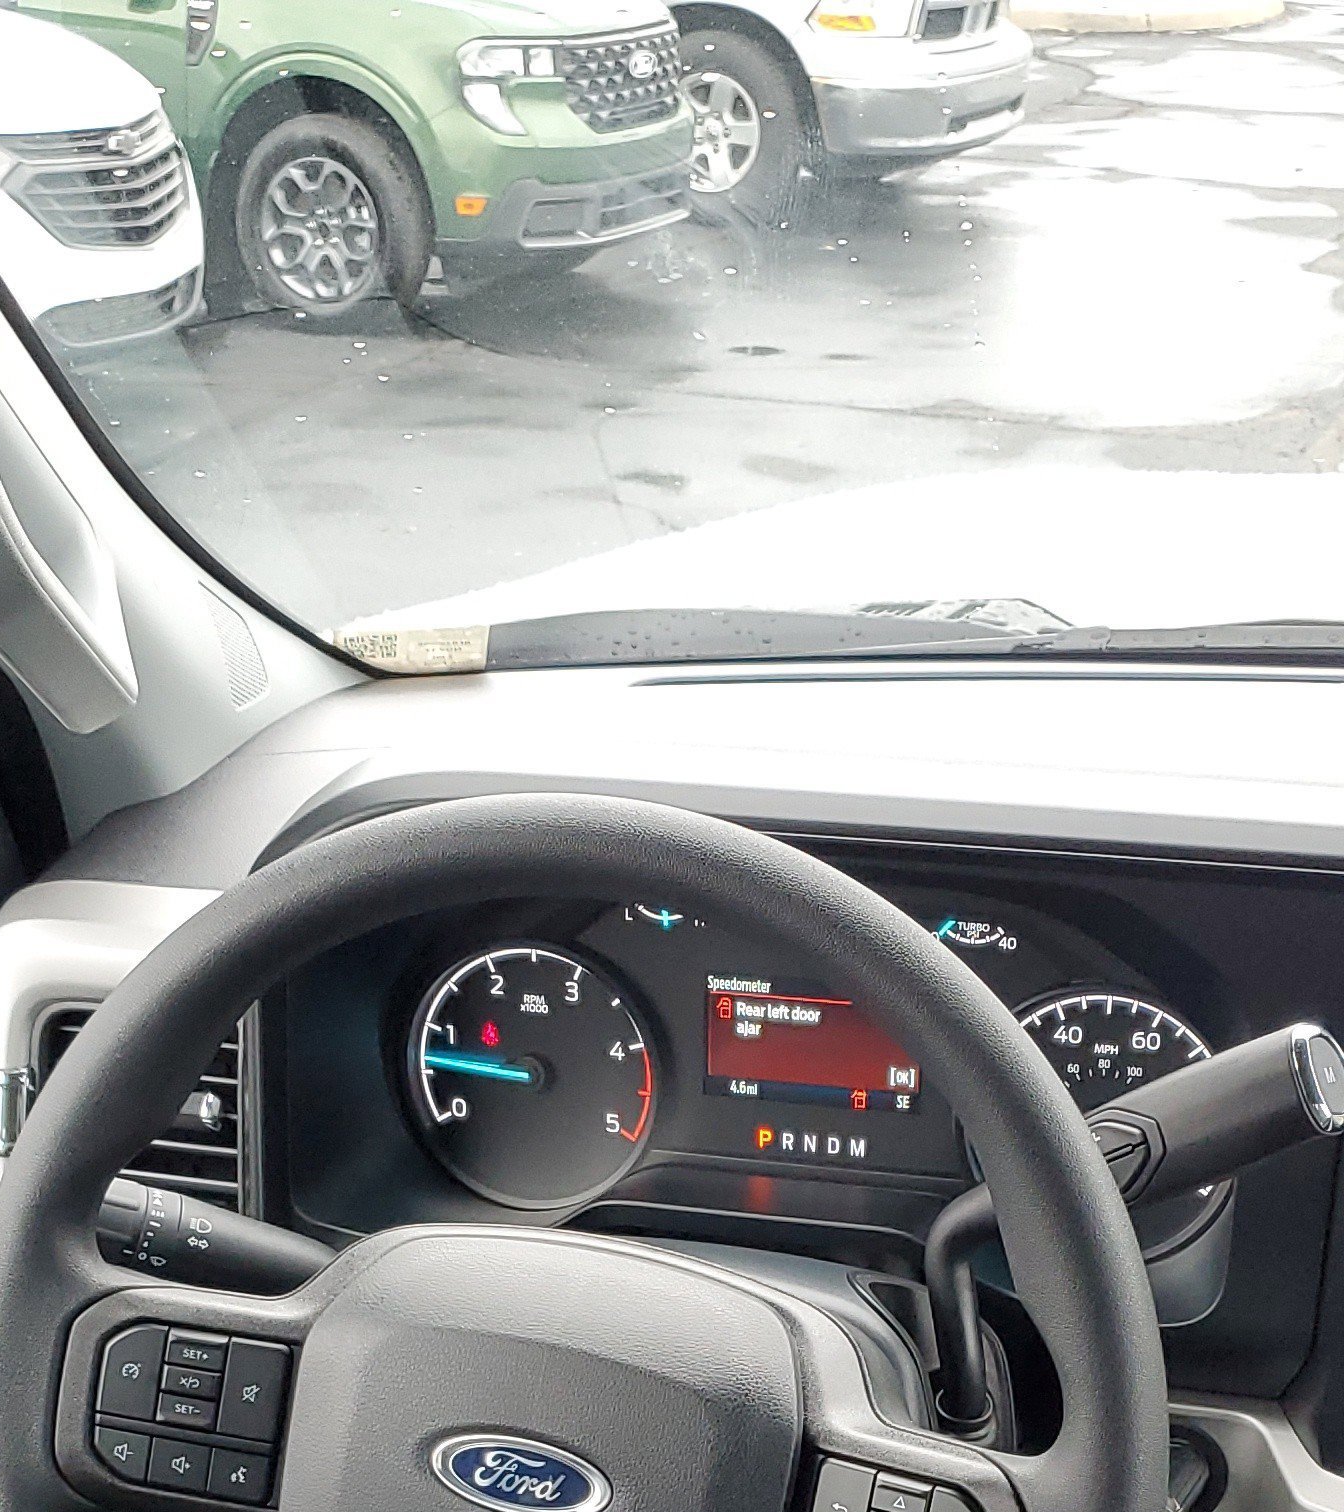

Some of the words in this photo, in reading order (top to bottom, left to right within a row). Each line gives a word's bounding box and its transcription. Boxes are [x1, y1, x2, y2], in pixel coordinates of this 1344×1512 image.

[957, 921, 991, 932] TURBO
[998, 936, 1017, 950] 40
[490, 975, 504, 995] 2
[565, 982, 579, 1002] 3
[707, 976, 771, 993] Speedometer
[523, 994, 546, 1005] RPM
[520, 1003, 548, 1014] x1000
[736, 1001, 765, 1017] Rear
[768, 1004, 790, 1020] left
[792, 1006, 821, 1023] door
[446, 1025, 455, 1045] 1
[736, 1021, 761, 1037] ajar
[1053, 1026, 1083, 1044] 40
[1094, 1043, 1119, 1055] MPH
[1132, 1032, 1161, 1050] 60
[609, 1041, 625, 1061] 4
[1067, 1063, 1080, 1074] 60
[1098, 1058, 1111, 1069] 80
[1126, 1066, 1143, 1077] 100
[451, 1098, 467, 1117] 0
[896, 1095, 910, 1109] SE
[606, 1114, 620, 1133] 5
[759, 1129, 772, 1148] P
[782, 1132, 794, 1151] R
[804, 1134, 817, 1153] N
[827, 1137, 840, 1154] D
[850, 1138, 865, 1158] M
[475, 1450, 566, 1502] Ford
